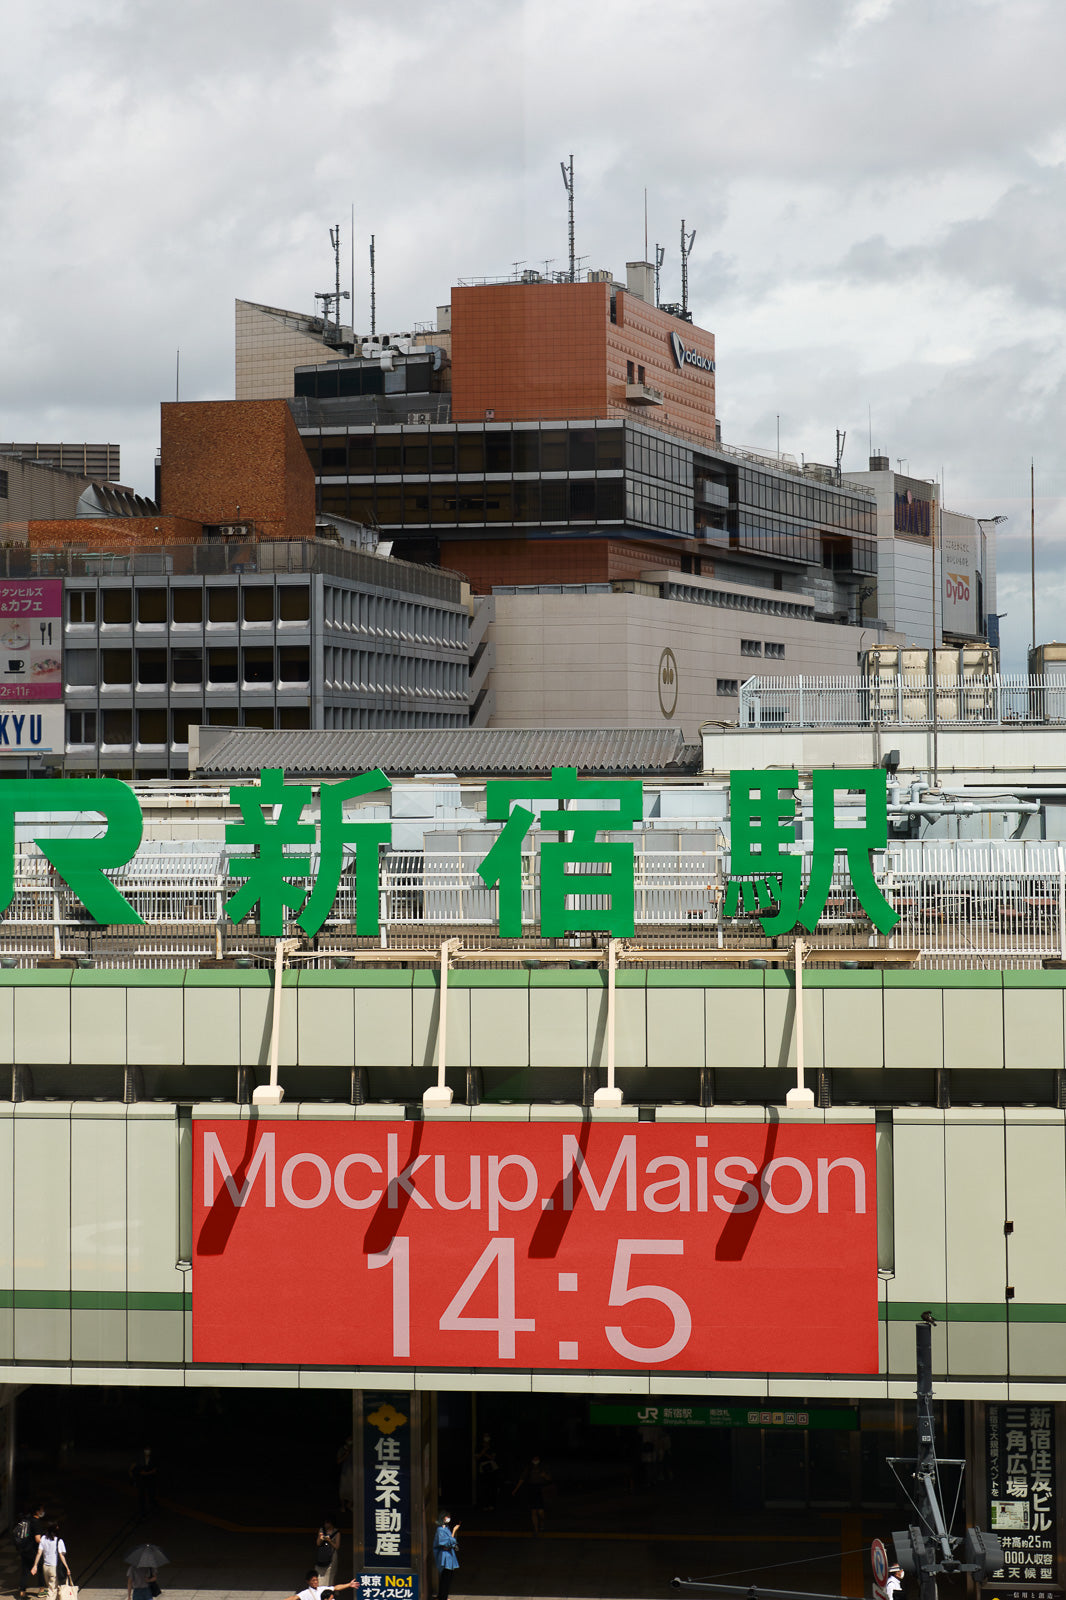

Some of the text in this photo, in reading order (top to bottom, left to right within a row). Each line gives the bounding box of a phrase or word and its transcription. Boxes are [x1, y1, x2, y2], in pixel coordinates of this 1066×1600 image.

[685, 349, 716, 372] odakyu
[0, 587, 43, 597] タンヒルズ
[946, 579, 970, 605] DyDo
[1, 599, 43, 612] &カフェ
[0, 714, 42, 745] KYU
[0, 779, 145, 926] R
[201, 1131, 867, 1232] Mockup.Maison
[637, 1408, 693, 1420] JR 新宿駅
[1006, 1407, 1029, 1498] 三角広場
[1030, 1407, 1053, 1532] 新宿住友ビル
[374, 1438, 401, 1556] 住友不動産
[997, 1535, 1052, 1549] 井高約25m
[1004, 1551, 1053, 1565] 000人収容
[360, 1575, 412, 1587] 東京 No.1
[362, 1588, 414, 1598] オフィスビル
